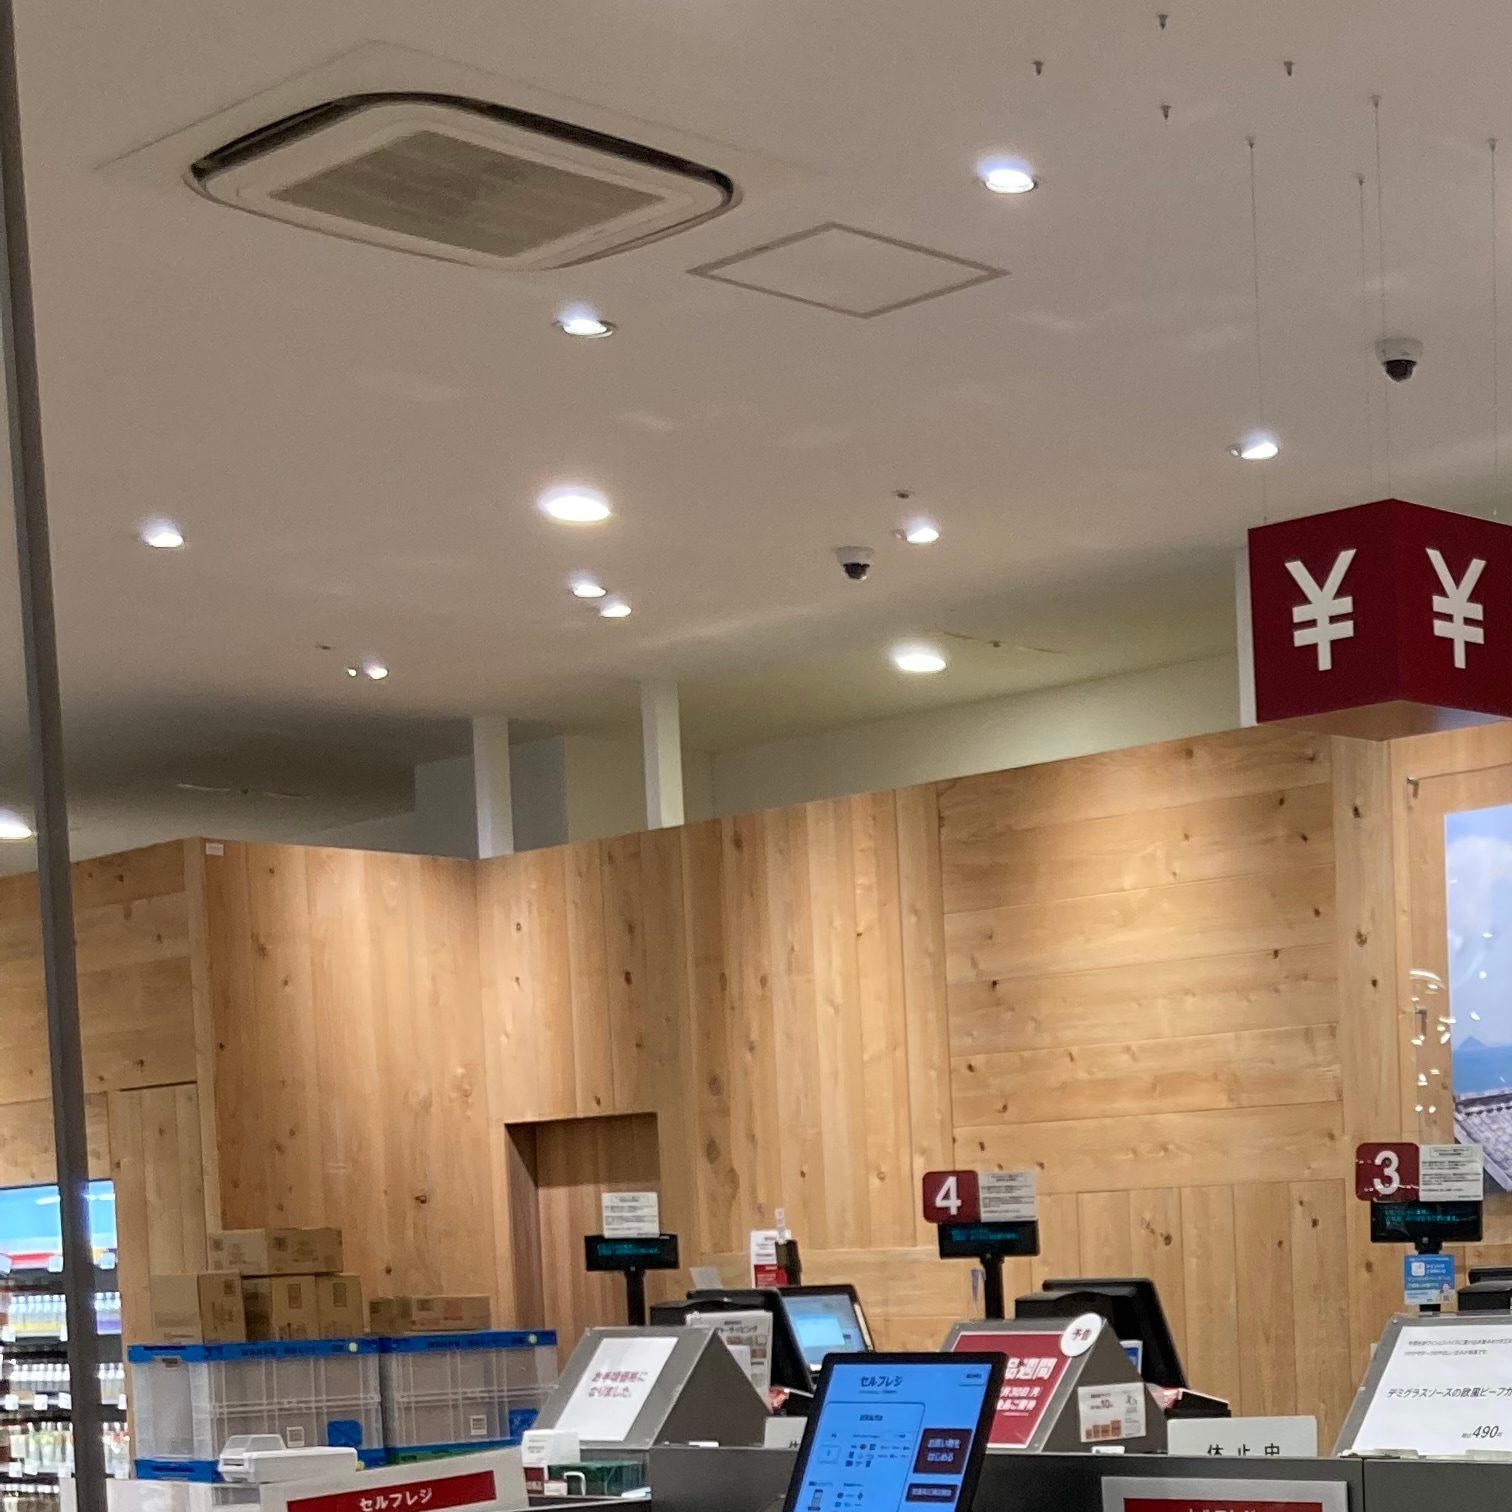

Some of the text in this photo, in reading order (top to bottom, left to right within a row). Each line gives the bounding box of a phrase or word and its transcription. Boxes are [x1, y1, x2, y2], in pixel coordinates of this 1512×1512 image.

[1373, 1150, 1400, 1195] 3
[935, 1176, 962, 1216] 4
[860, 1375, 904, 1388] セルフレジ
[359, 1487, 433, 1512] セルフレジ
